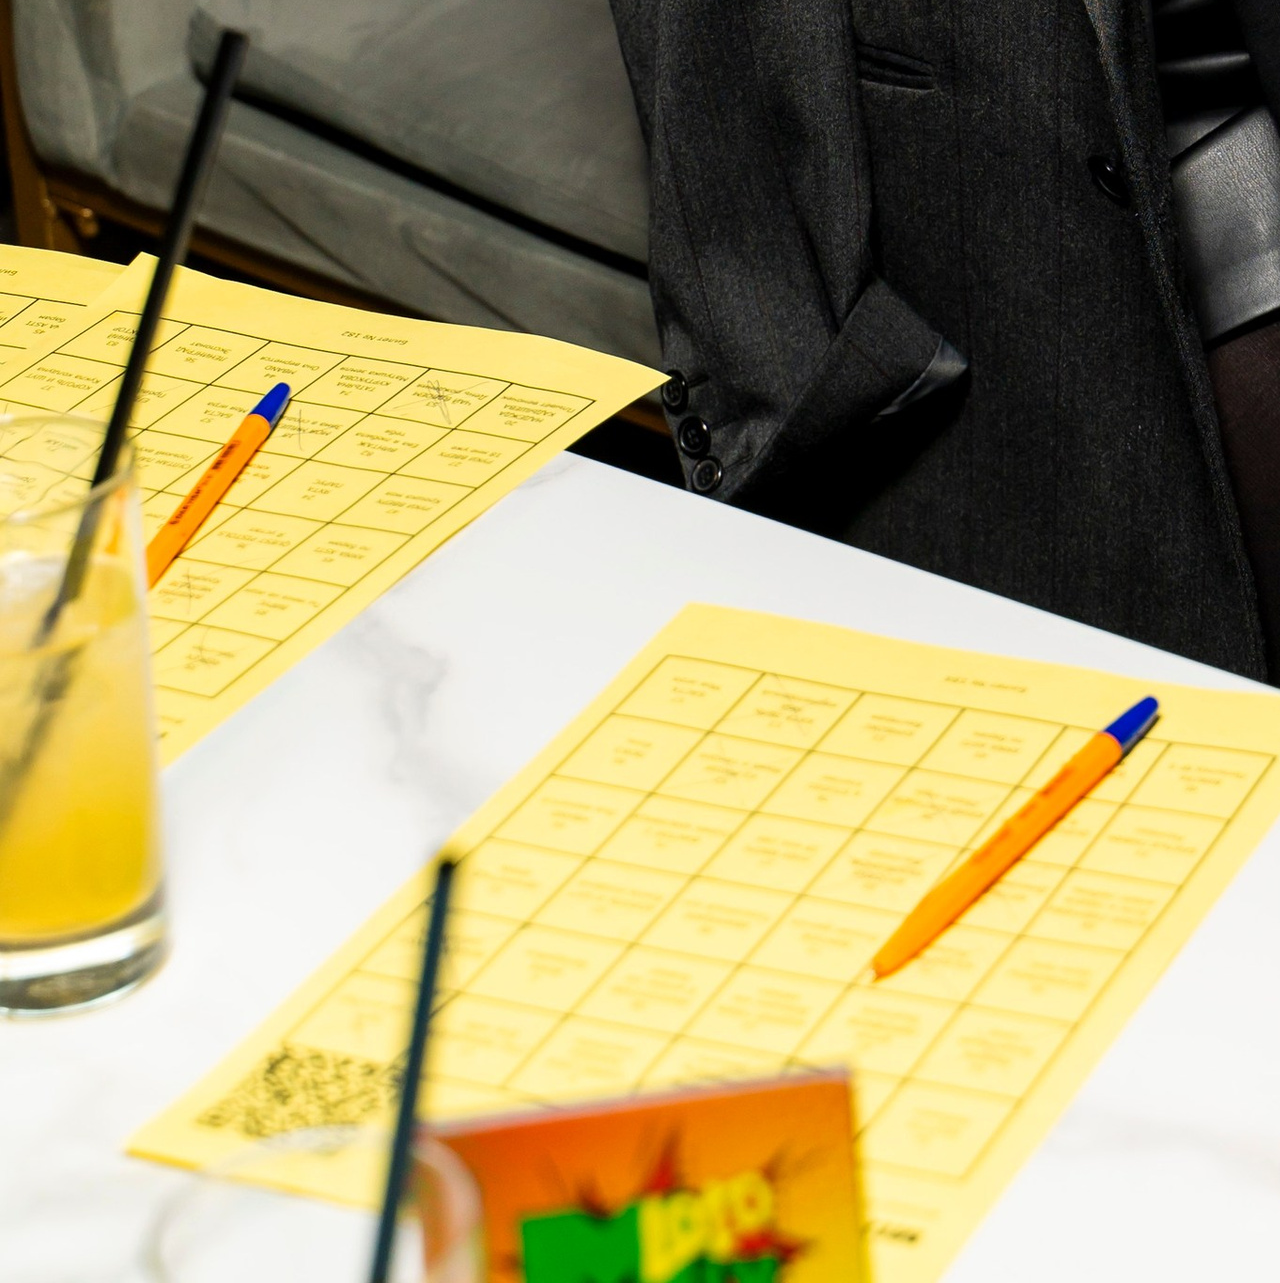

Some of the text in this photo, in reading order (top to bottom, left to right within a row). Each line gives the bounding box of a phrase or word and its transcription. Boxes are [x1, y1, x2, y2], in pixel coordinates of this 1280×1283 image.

[25, 320, 48, 329] ASTI
[377, 337, 408, 345] Билет
[190, 342, 232, 354] Экспонат
[175, 346, 227, 362] ЛЕНИНГРАД
[36, 367, 101, 384] Кукла колдуна
[340, 374, 391, 386] КУРТУКОВА
[368, 371, 409, 382] Матушка
[56, 379, 92, 390] КОРОЛЬ
[336, 381, 376, 392] ТАТЬЯНА
[464, 391, 488, 400] День
[452, 398, 471, 406] ЧАЙ
[203, 409, 233, 418] БАСТА
[503, 404, 556, 417] КАДЫШЕВА
[499, 411, 544, 423] НАДЕЖДА
[357, 441, 398, 453] ВИНТАЖ
